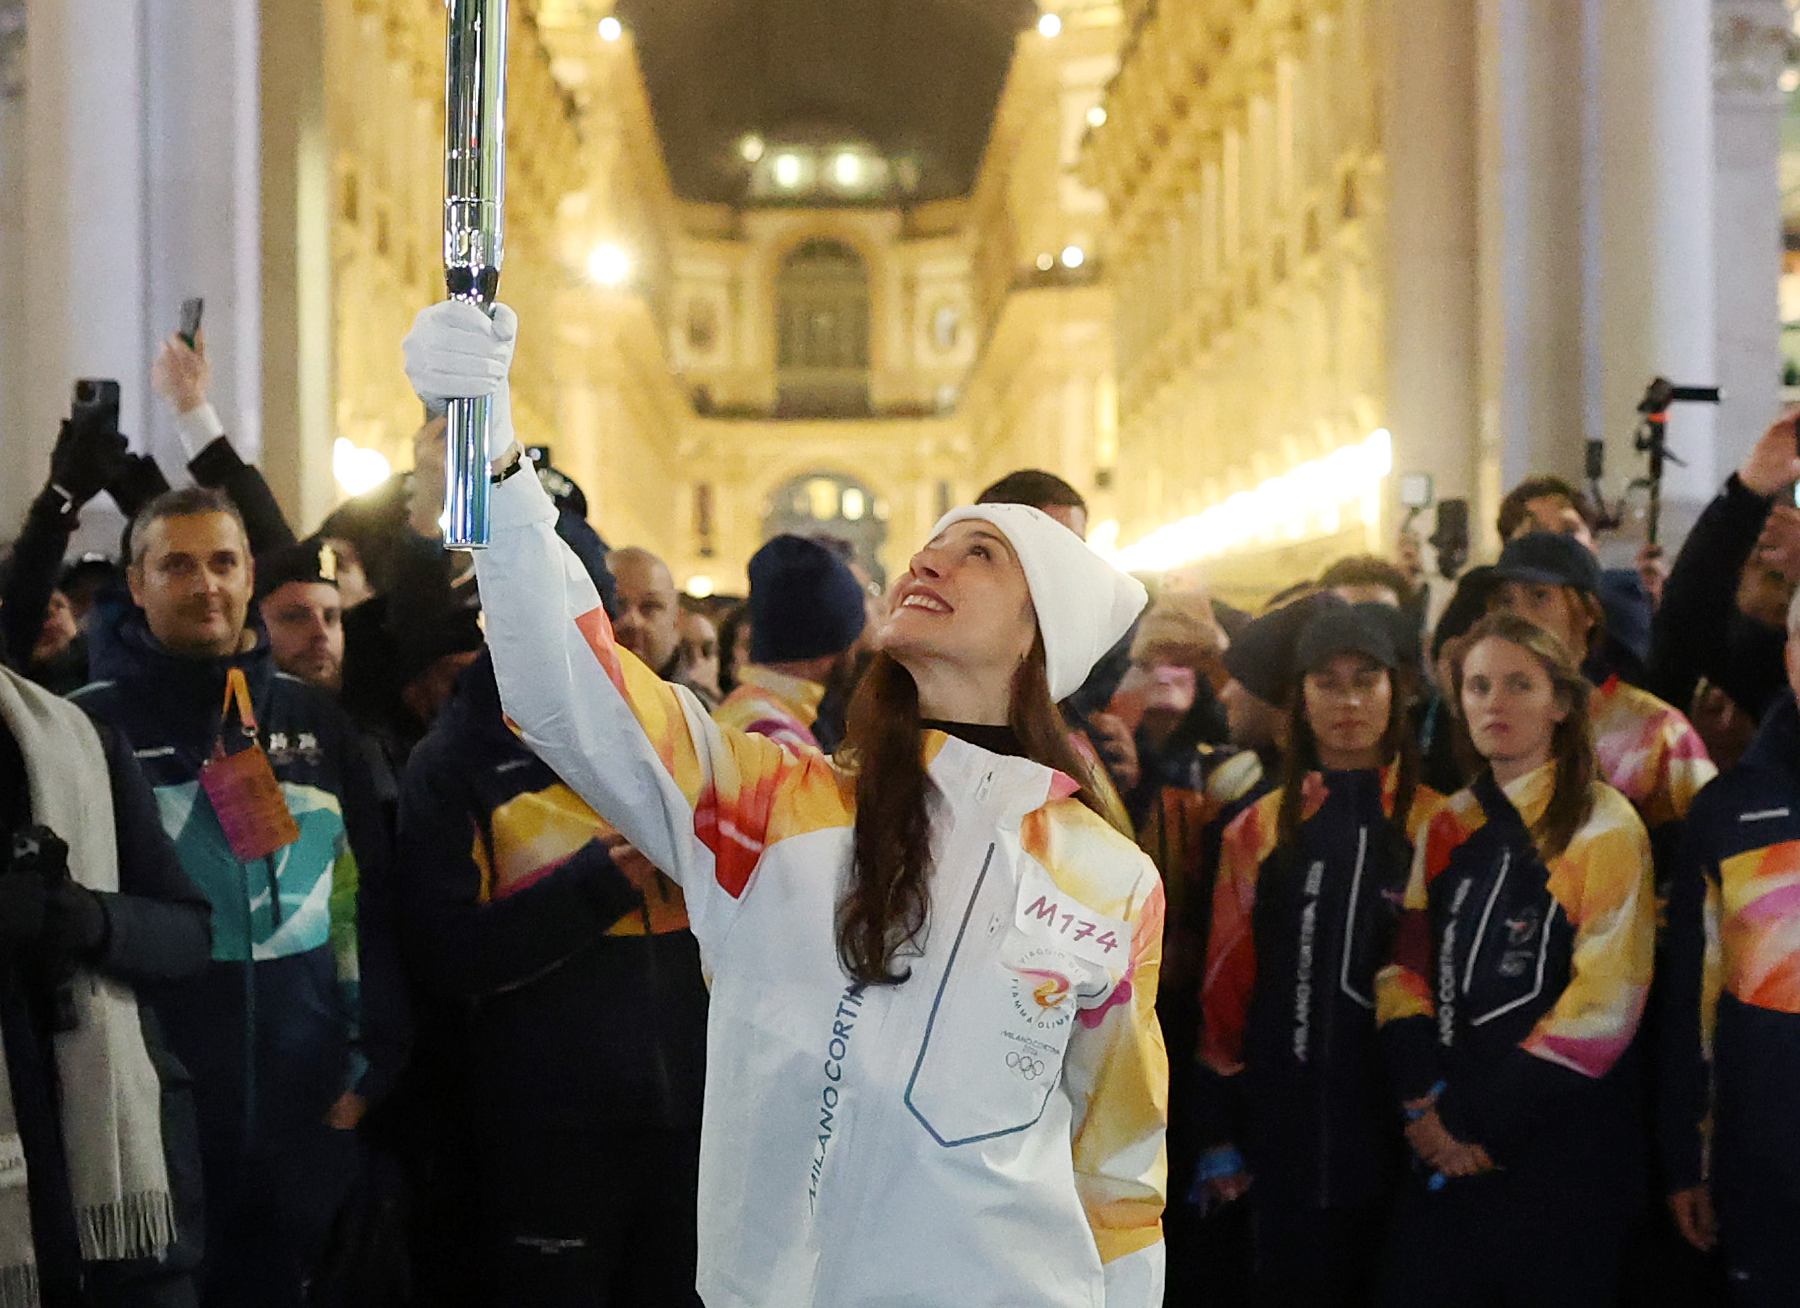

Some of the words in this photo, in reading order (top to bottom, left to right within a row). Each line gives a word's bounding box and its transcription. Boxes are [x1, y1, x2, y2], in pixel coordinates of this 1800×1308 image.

[1023, 895, 1119, 954] M174
[1011, 977, 1033, 1024] FIAMMA
[808, 1086, 840, 1217] MILANO
